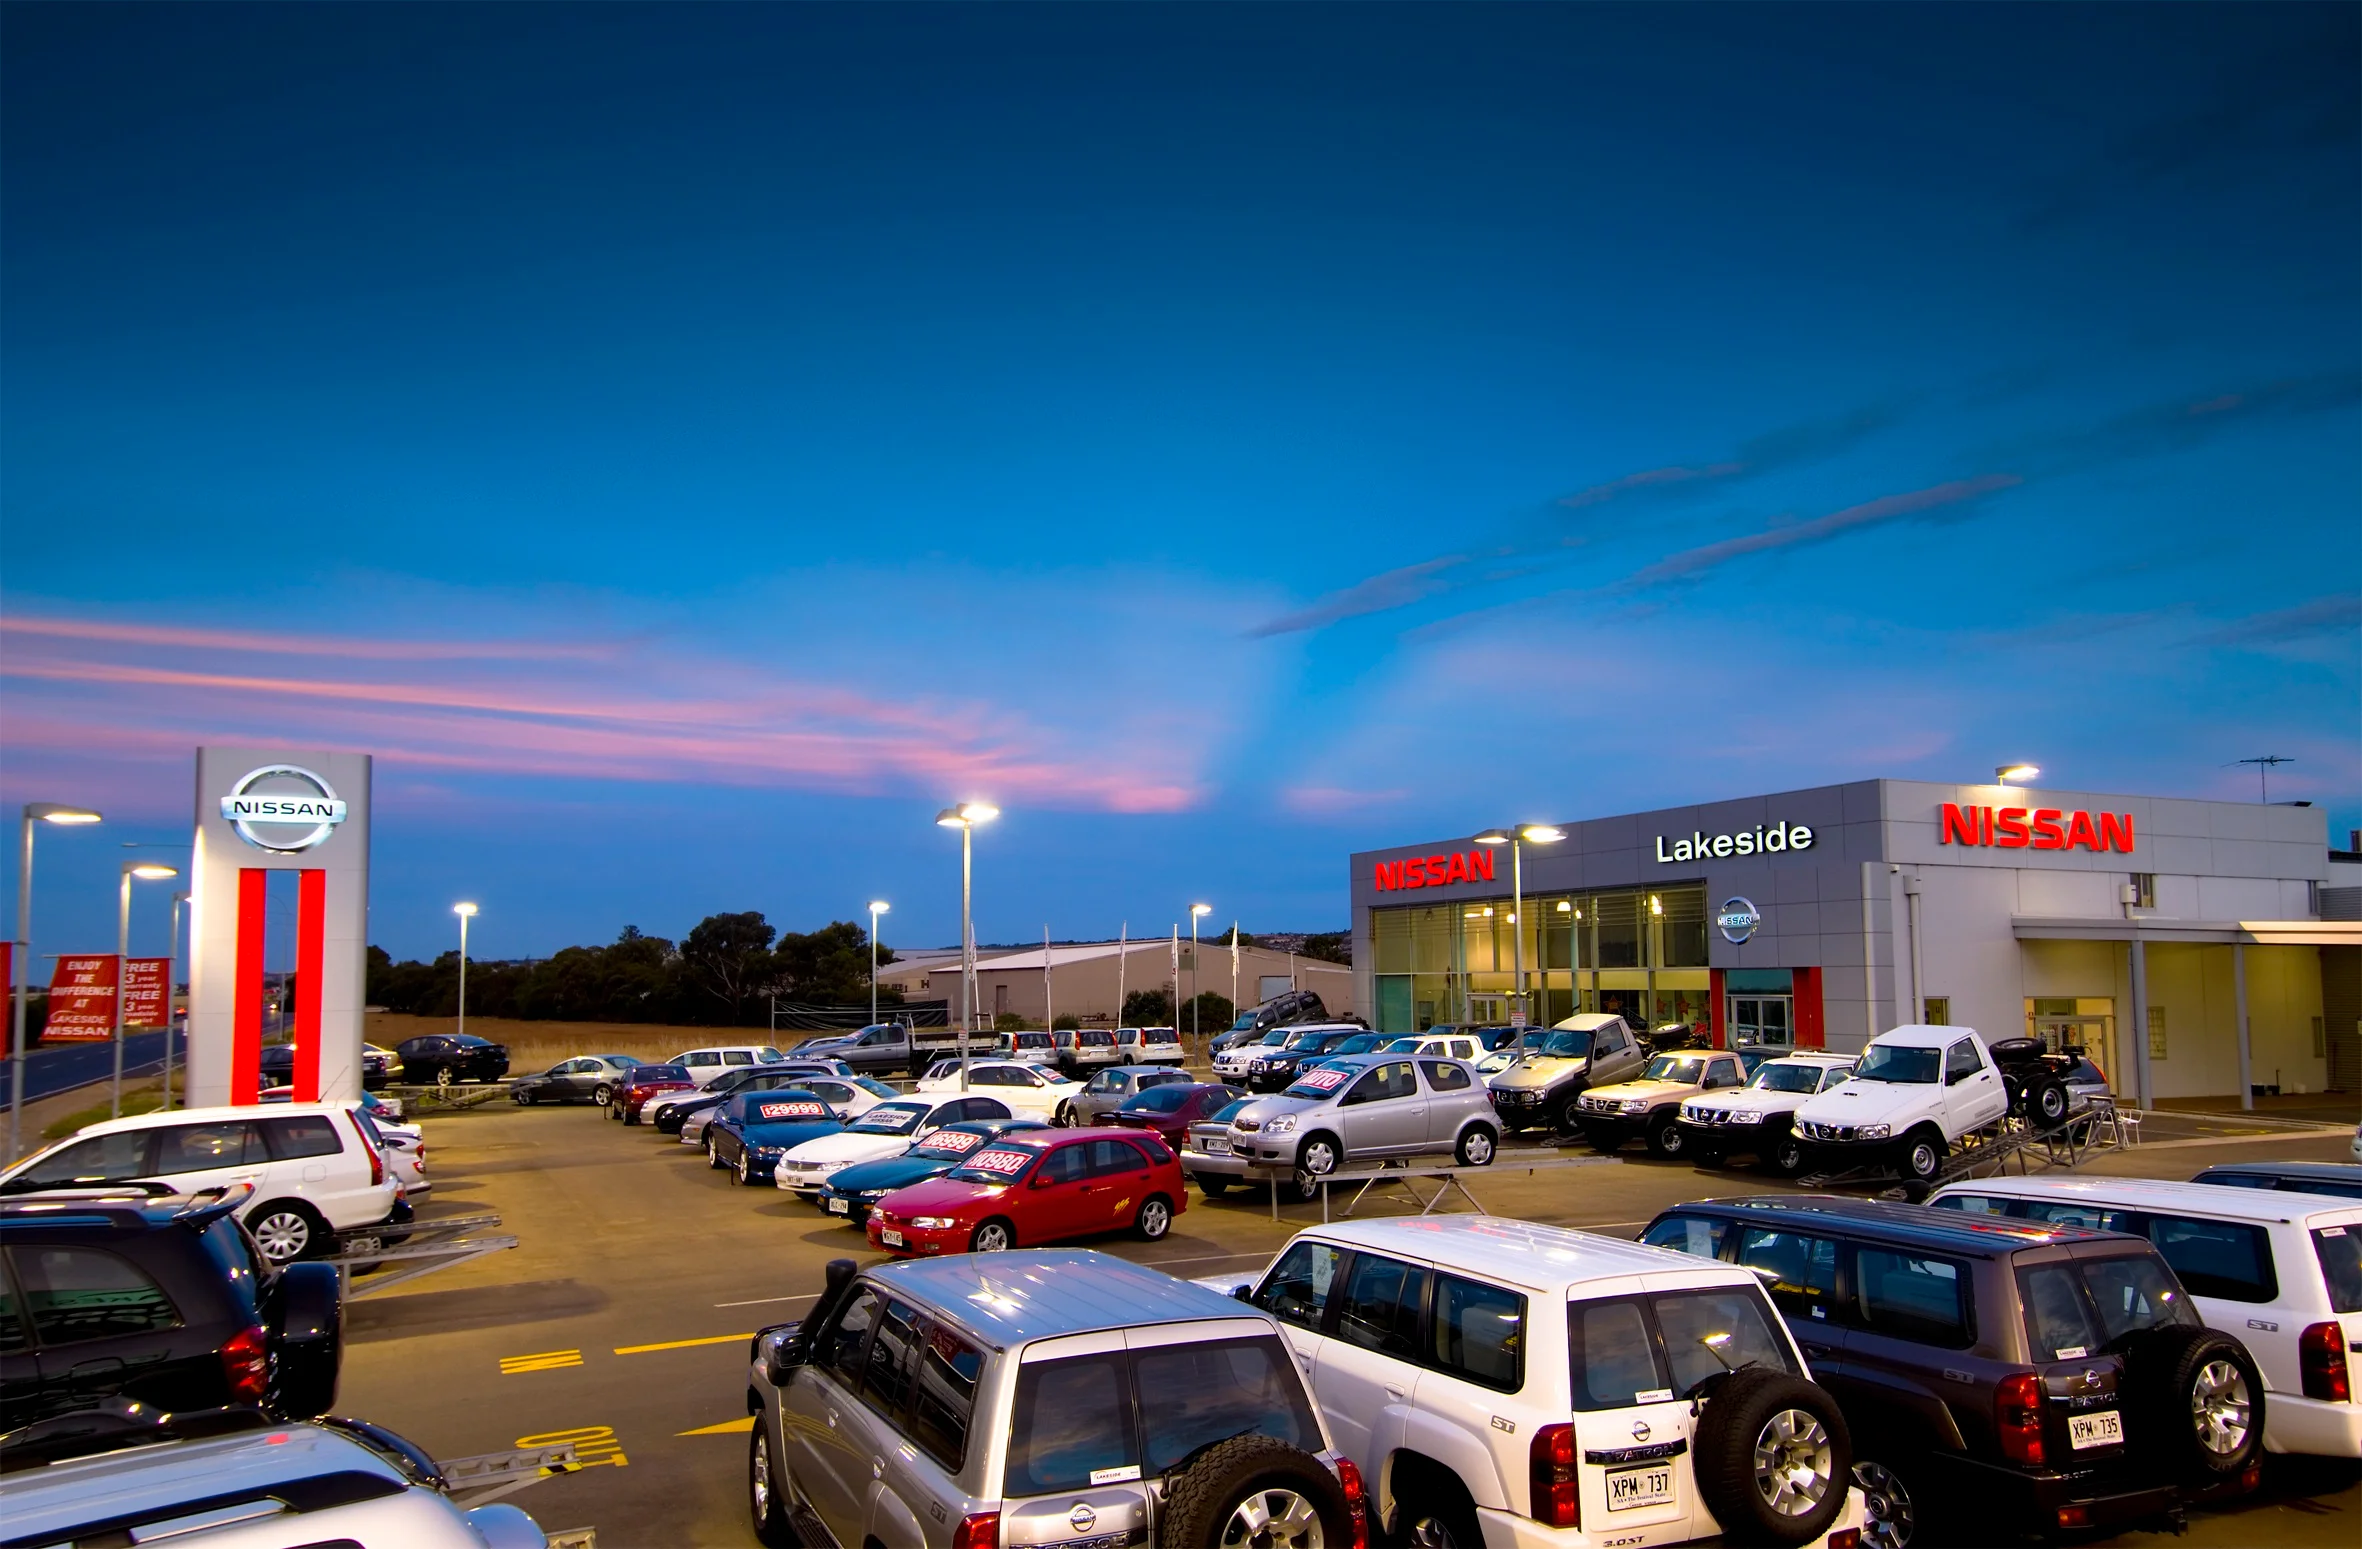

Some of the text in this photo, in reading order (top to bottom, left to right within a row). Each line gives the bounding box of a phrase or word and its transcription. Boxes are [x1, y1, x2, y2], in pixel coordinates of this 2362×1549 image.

[234, 801, 333, 816] NISSAN
[1939, 803, 2134, 853] NISSAN
[1656, 821, 1813, 863] Lakeside
[1375, 849, 1494, 891] NISSAN
[1718, 912, 1754, 926] NISSAN
[67, 961, 103, 971] ENJOY
[74, 974, 95, 984] THE
[125, 973, 136, 984] 3
[51, 986, 115, 997] DIFFERENCE
[73, 999, 90, 1008] AT
[125, 1001, 135, 1012] 3
[50, 1010, 108, 1024] LAKESIDE
[44, 1027, 110, 1036] NISSAN
[1298, 1071, 1343, 1088] AUTO
[765, 1103, 821, 1116] $29999
[2248, 1320, 2277, 1331] ST
[1492, 1417, 1515, 1432] ST
[2073, 1420, 2094, 1439] XPM
[2100, 1418, 2118, 1435] 735
[1615, 1443, 1674, 1462] PATROL
[1612, 1473, 1668, 1498] XPM 737
[1603, 1535, 1645, 1548] 3.0ST
